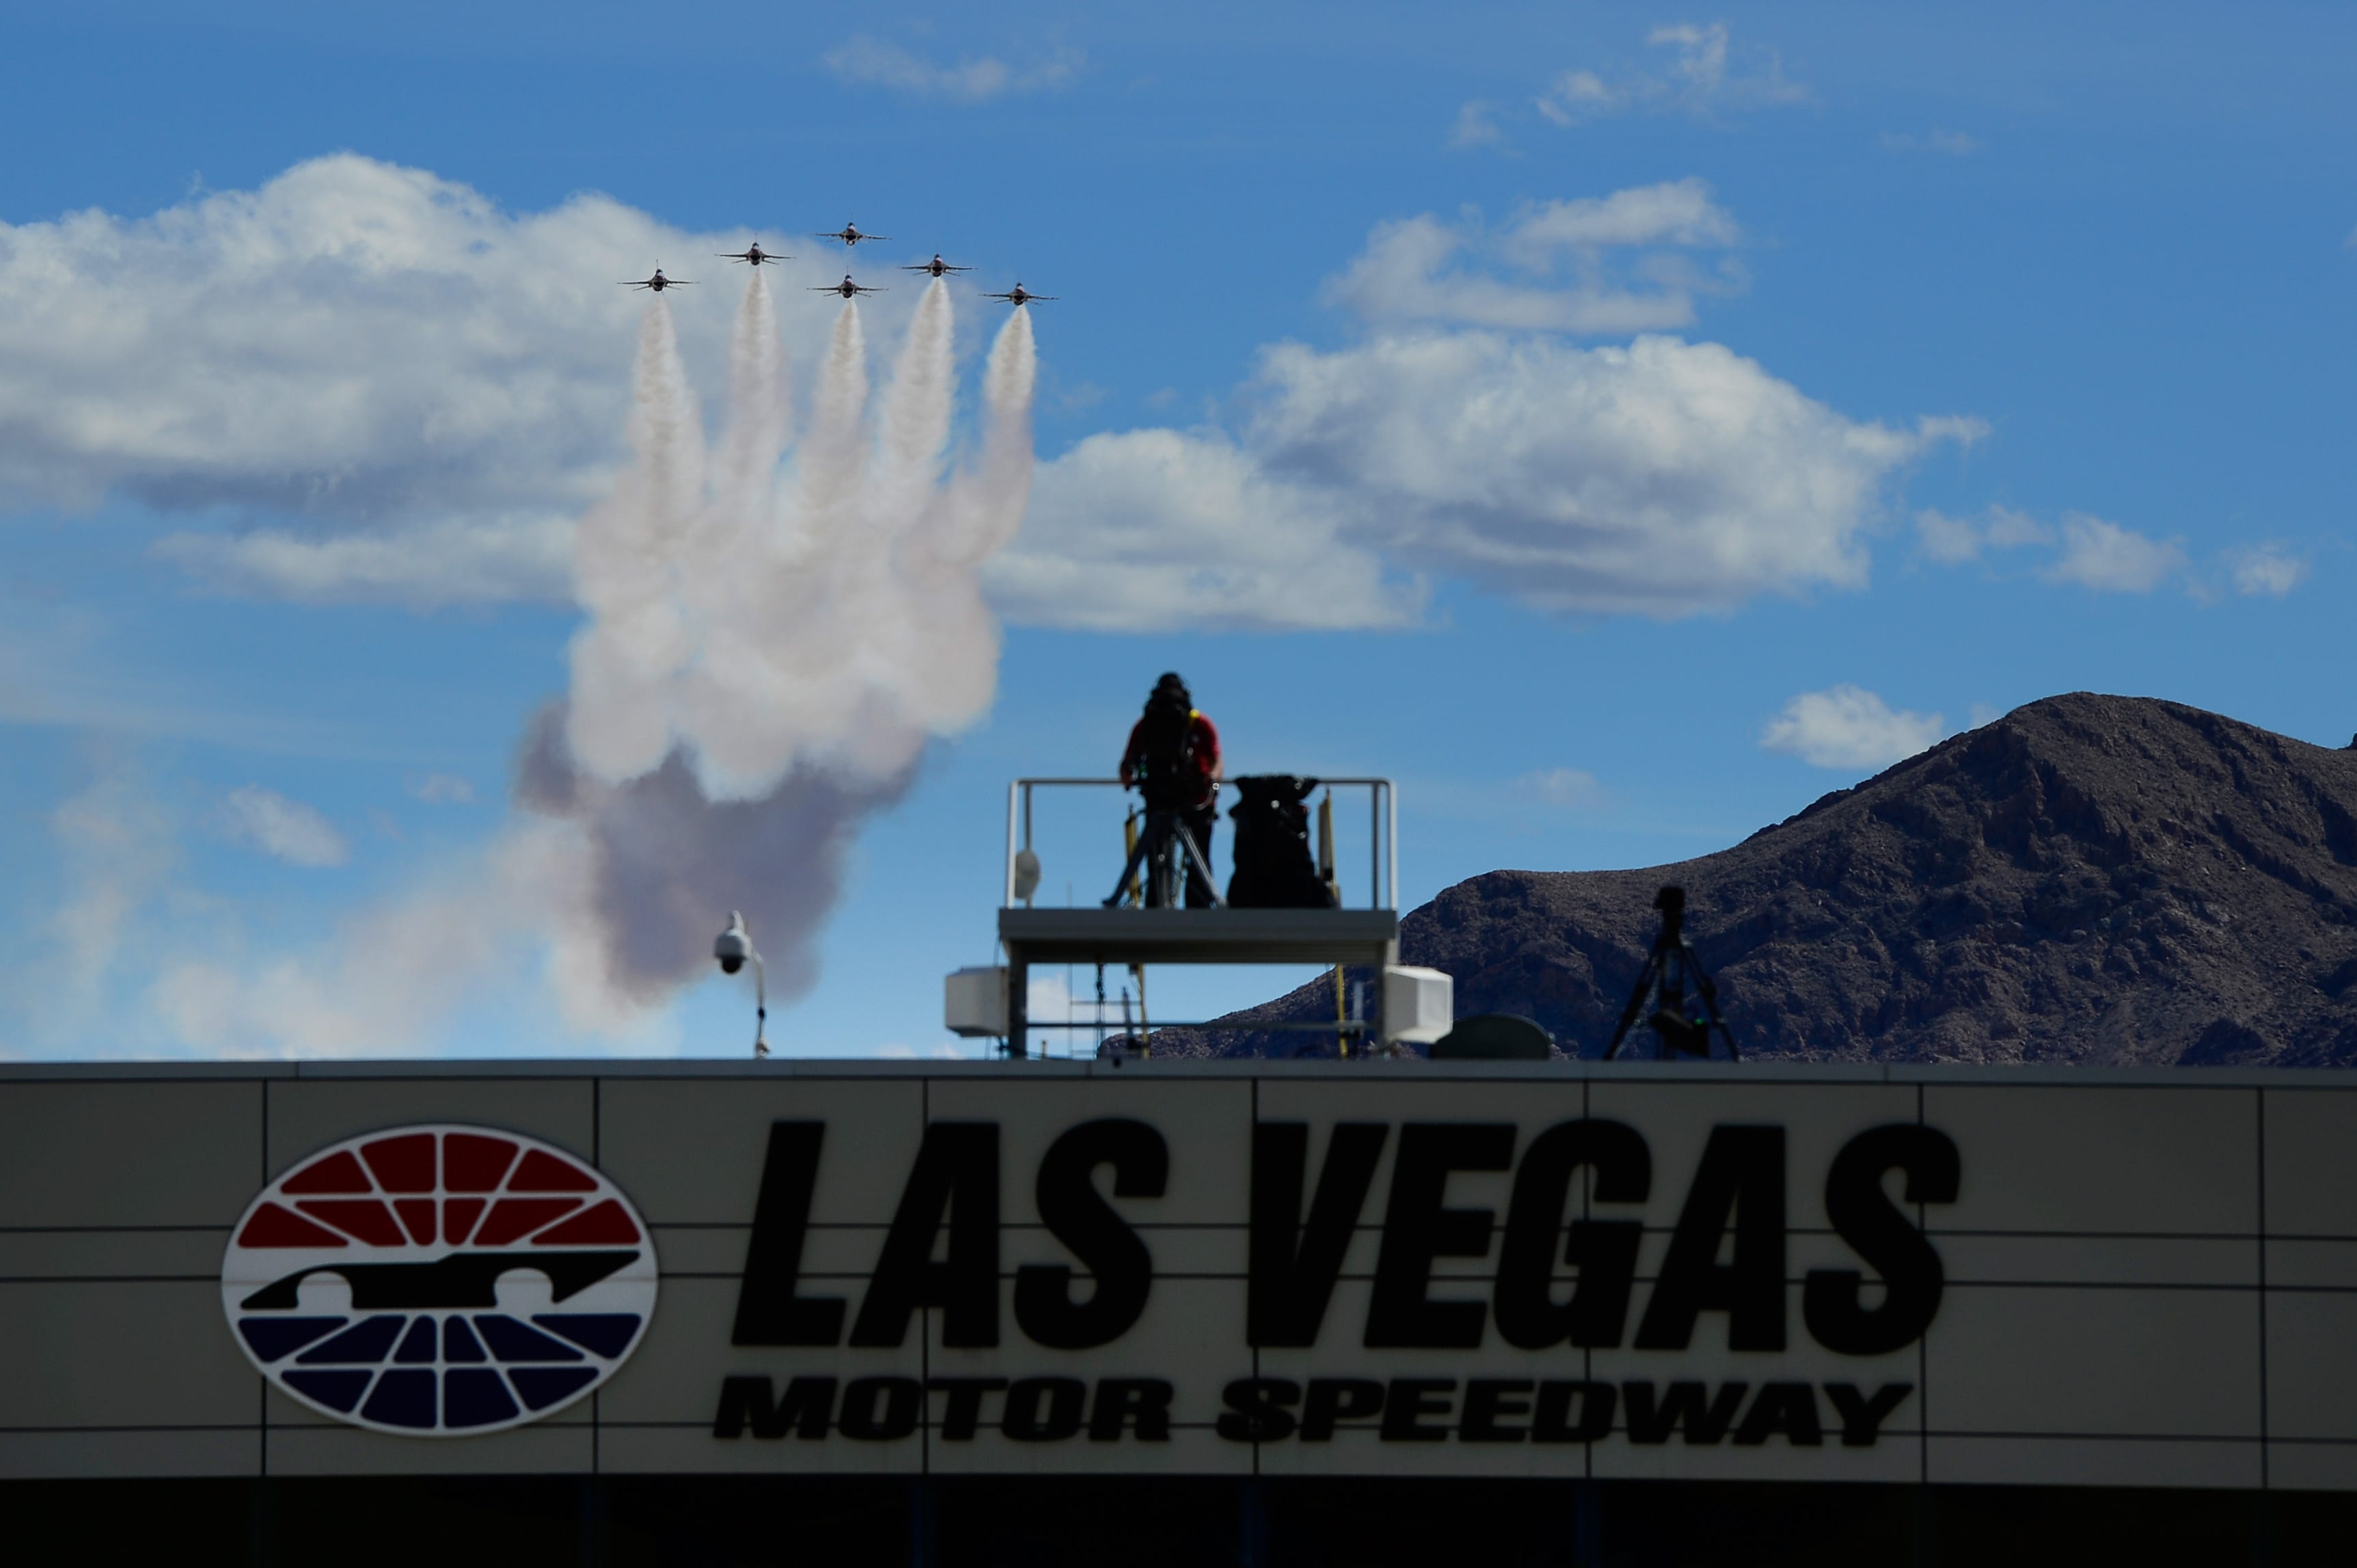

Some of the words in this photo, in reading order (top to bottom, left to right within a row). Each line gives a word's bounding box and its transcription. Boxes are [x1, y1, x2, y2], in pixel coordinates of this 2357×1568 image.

[732, 1118, 1169, 1350] LAS
[1246, 1118, 1961, 1356] VEGAS
[713, 1376, 1174, 1443] MOTOR
[1216, 1377, 1913, 1447] SPEEDWAY
